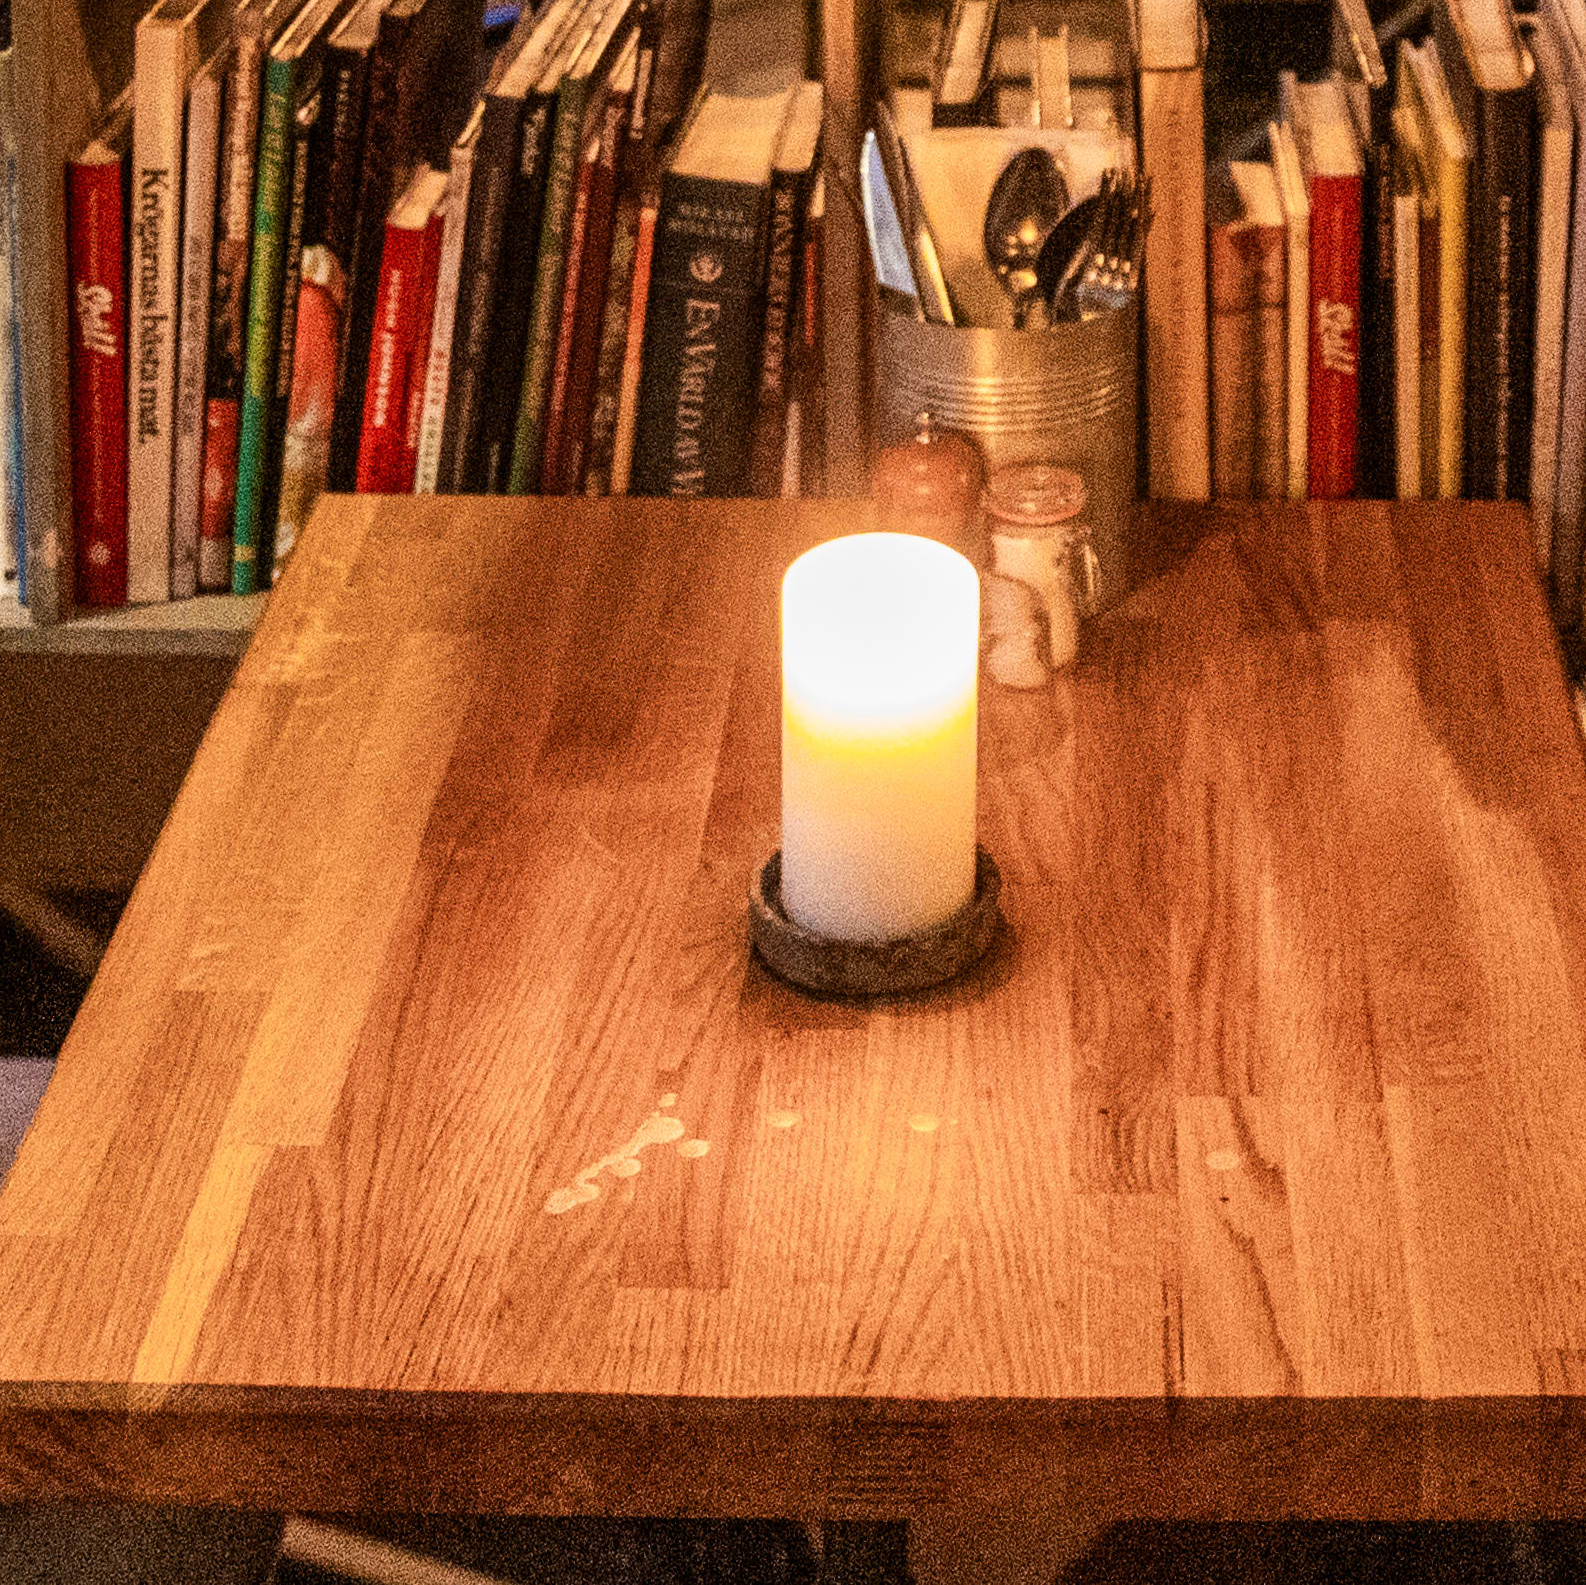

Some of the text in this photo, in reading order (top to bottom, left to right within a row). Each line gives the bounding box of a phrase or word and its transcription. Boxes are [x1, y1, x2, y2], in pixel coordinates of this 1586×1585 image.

[135, 168, 168, 445] Krögarnas bästa mat.
[371, 330, 396, 426] JOHNSON
